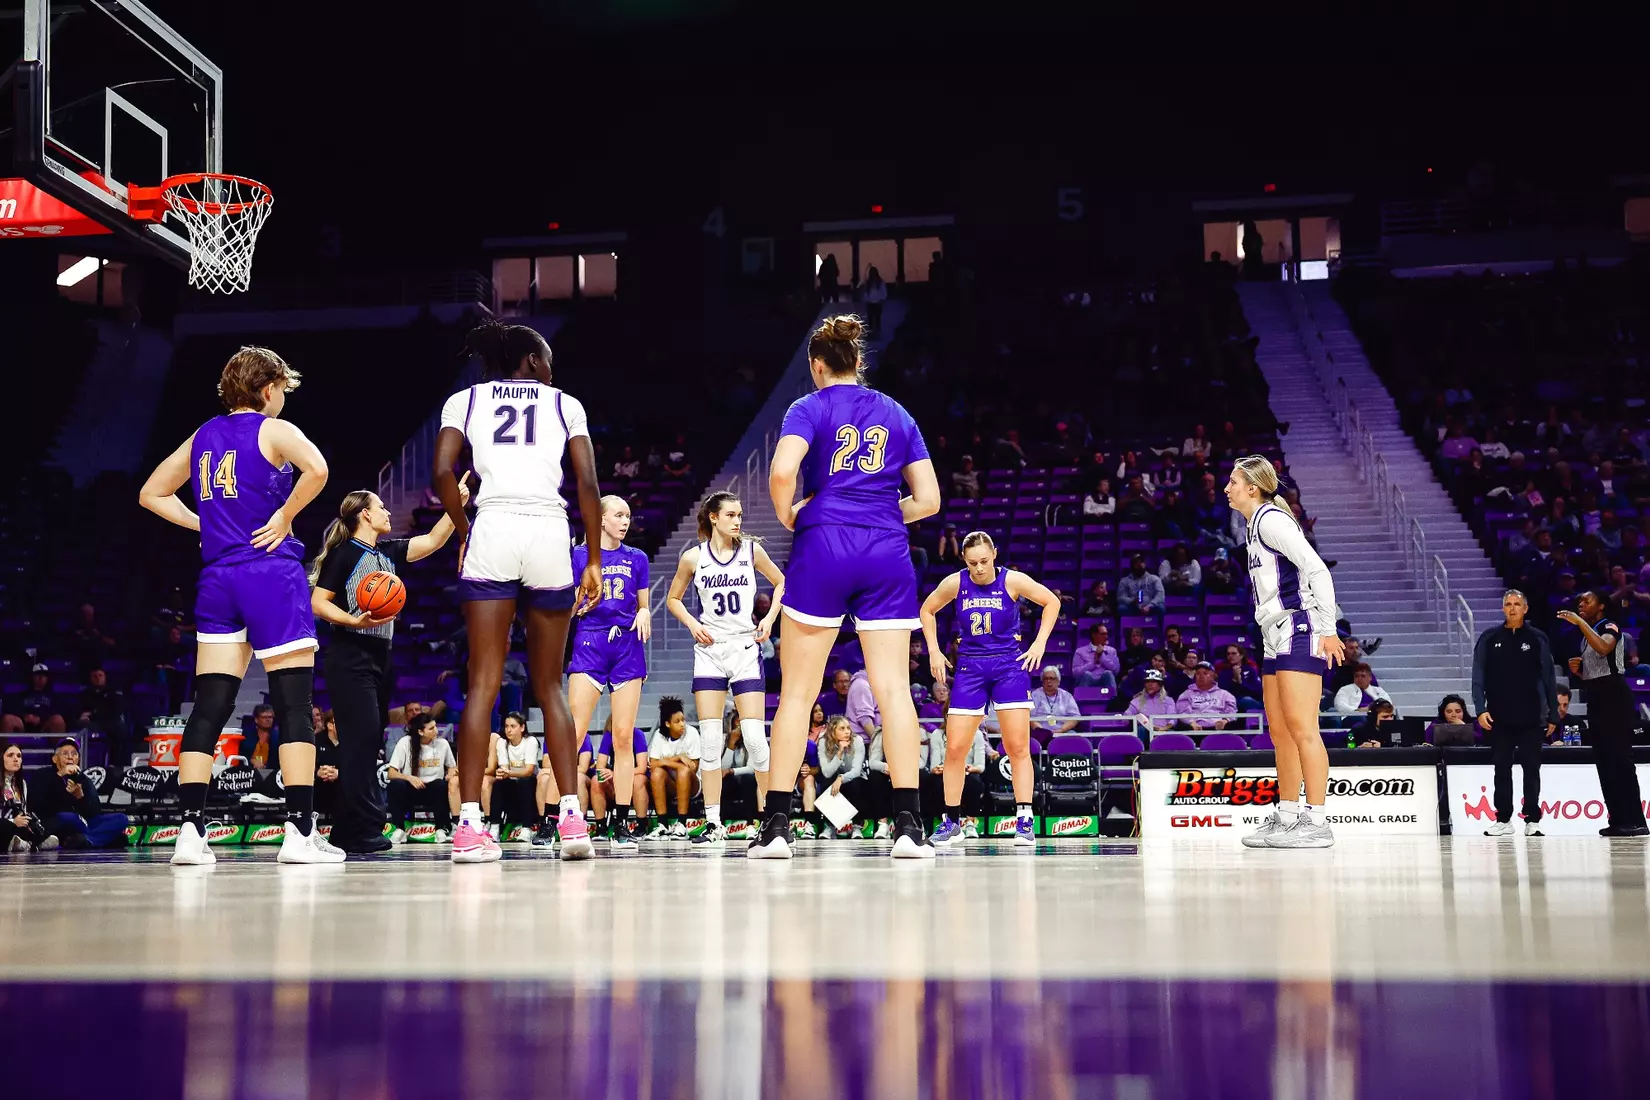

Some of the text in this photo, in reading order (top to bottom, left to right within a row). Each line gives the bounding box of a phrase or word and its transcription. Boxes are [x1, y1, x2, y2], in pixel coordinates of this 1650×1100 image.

[1057, 187, 1084, 221] 5
[702, 204, 727, 238] 4
[492, 385, 539, 399] MAUPIN
[493, 404, 537, 446] 21
[829, 423, 889, 476] 23
[199, 449, 238, 501] 14
[701, 573, 748, 589] Wildcats
[602, 577, 625, 600] 12
[712, 591, 741, 617] 30
[970, 611, 992, 636] 21
[156, 741, 167, 754] G
[1051, 758, 1090, 769] Capitol
[126, 768, 160, 782] Capitol
[219, 769, 255, 783] Capitol
[1052, 767, 1091, 778] Federal
[121, 777, 156, 792] Federal
[217, 779, 253, 791] Federal
[1173, 796, 1230, 804] AUTO GROUP
[1052, 817, 1089, 835] LIBMAN
[1170, 815, 1232, 827] GMC
[1378, 815, 1417, 823] GRADE
[995, 820, 1017, 834] LIBM
